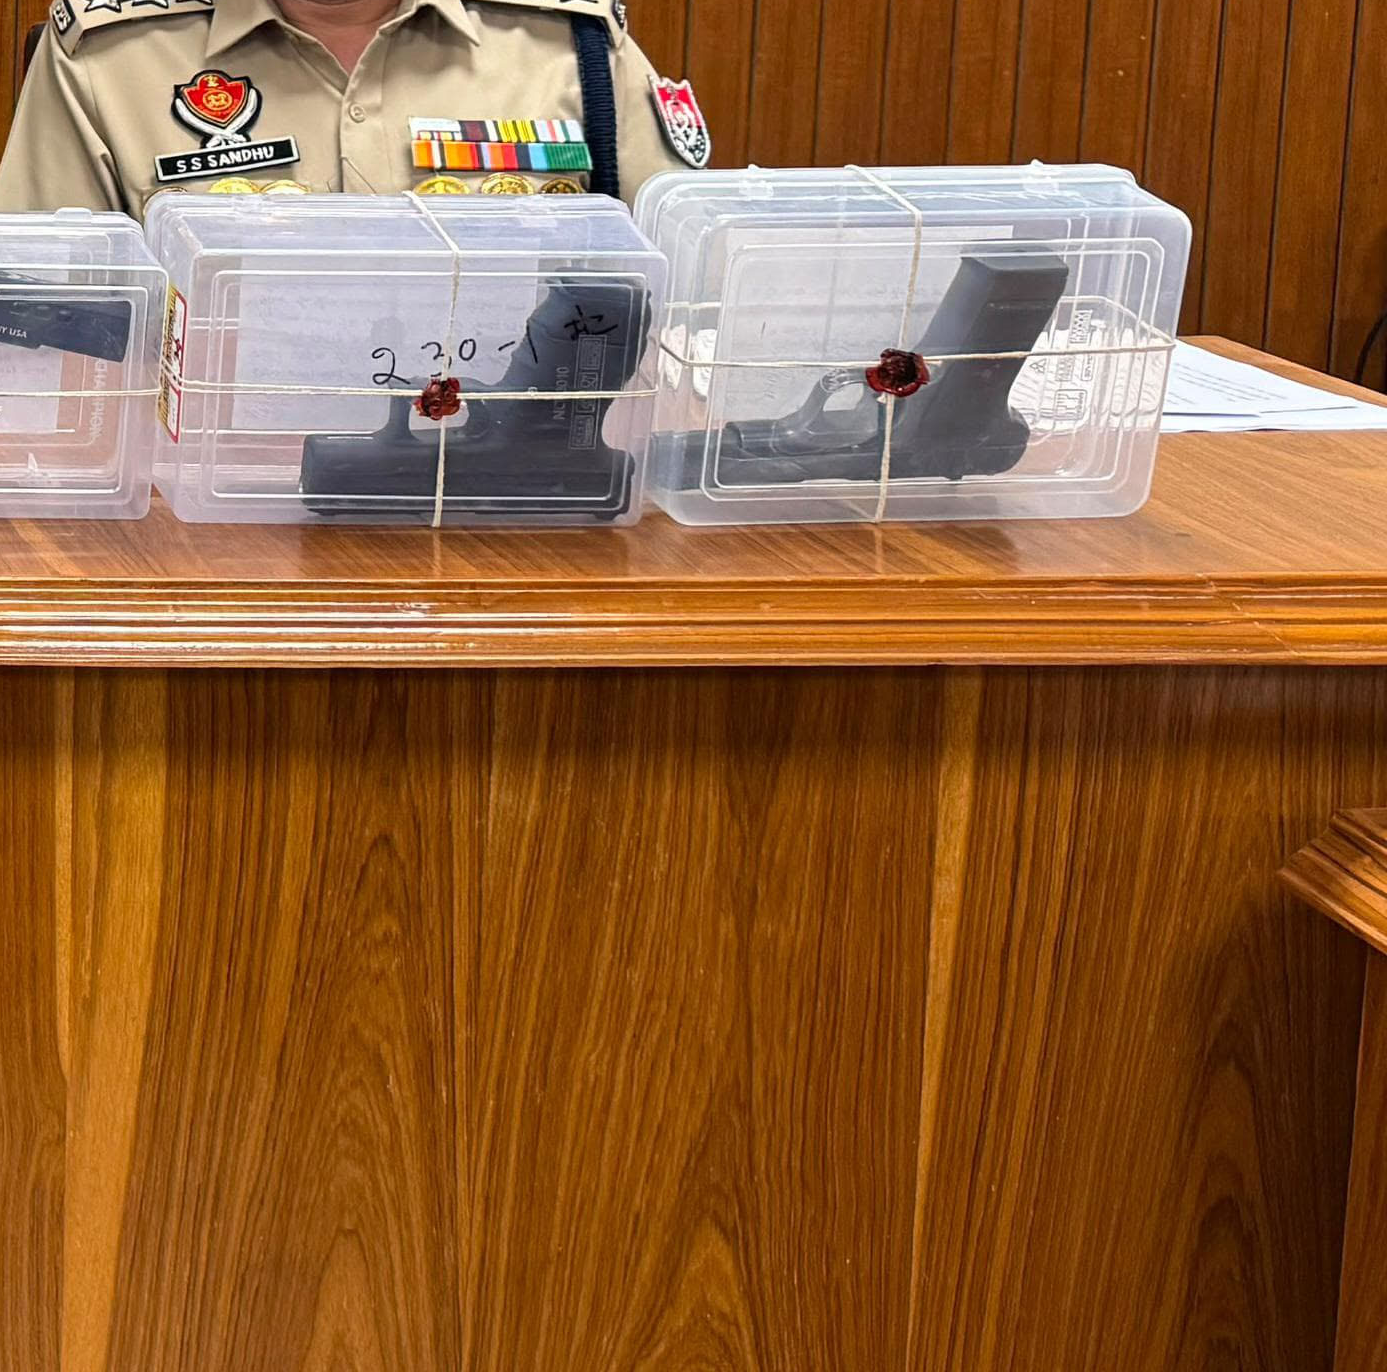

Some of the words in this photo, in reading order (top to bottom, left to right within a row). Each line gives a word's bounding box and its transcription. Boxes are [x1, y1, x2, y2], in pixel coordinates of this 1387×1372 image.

[176, 159, 188, 173] S
[190, 157, 203, 170] S
[207, 145, 275, 168] SANDHU
[9, 328, 27, 338] USA
